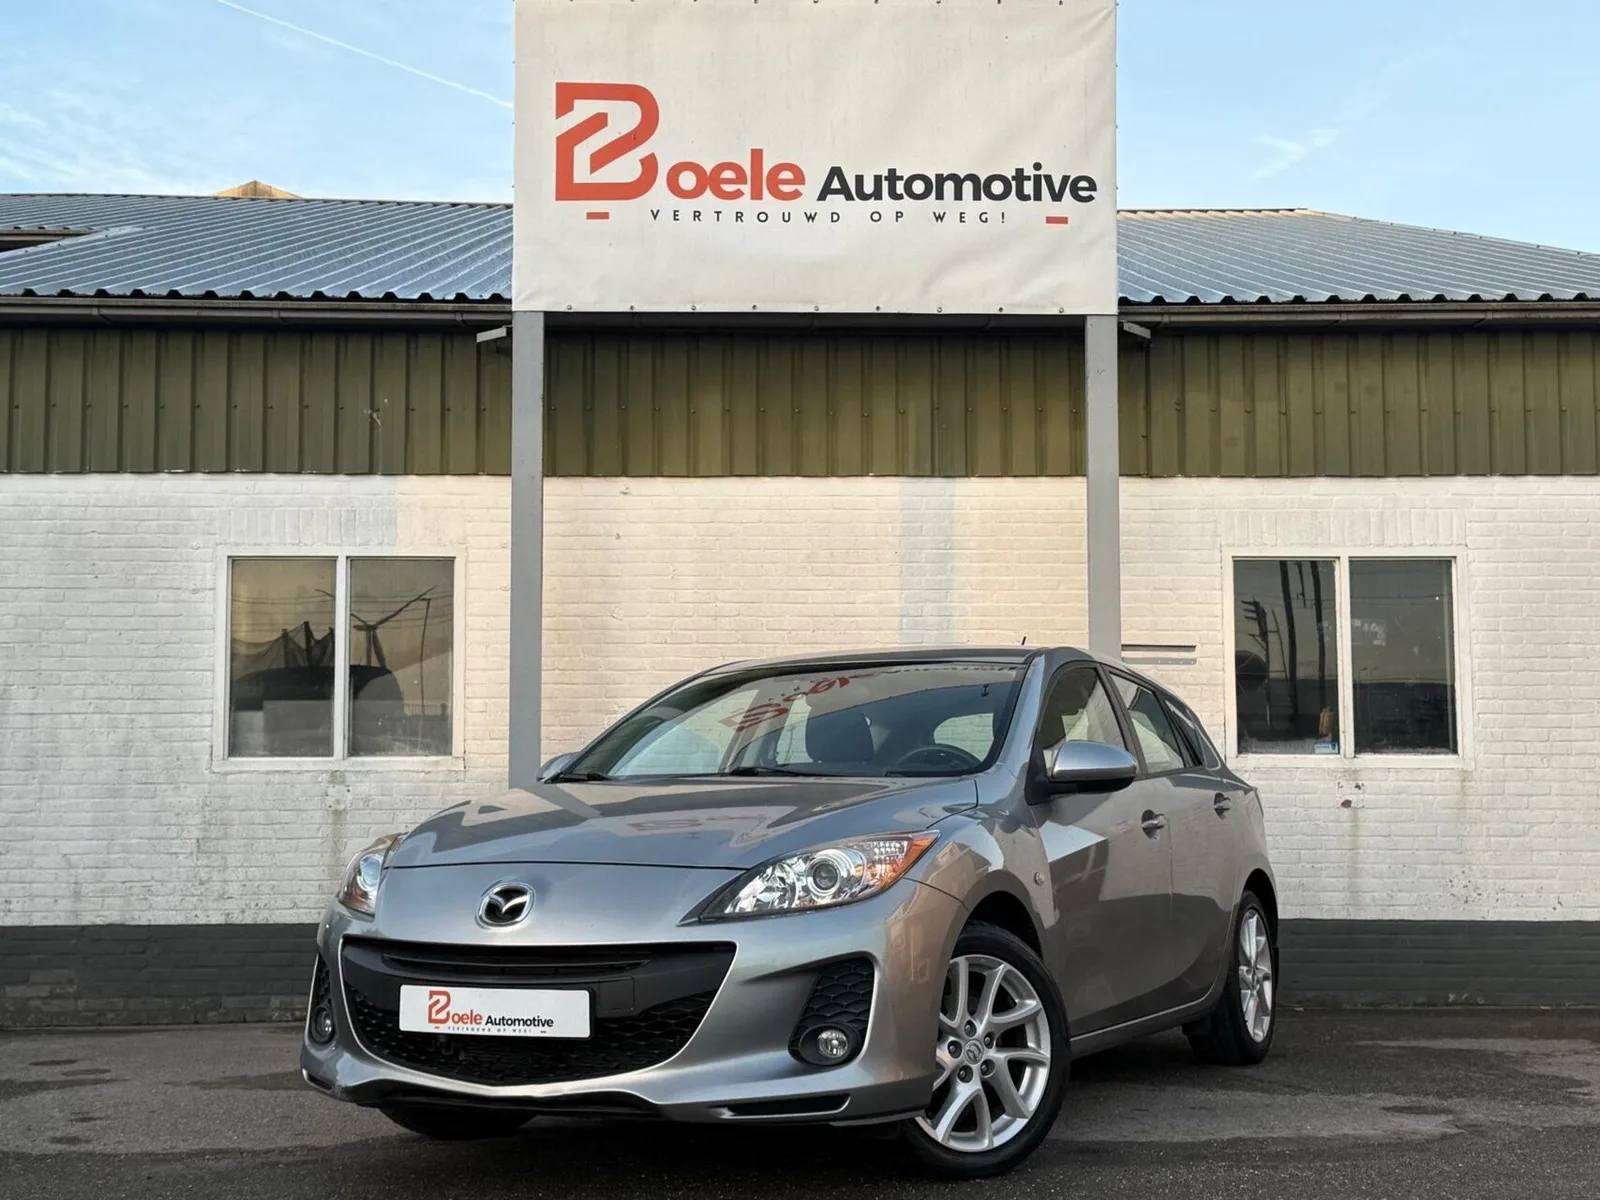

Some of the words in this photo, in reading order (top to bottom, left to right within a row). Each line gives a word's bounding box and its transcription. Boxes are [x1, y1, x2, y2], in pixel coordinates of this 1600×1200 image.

[556, 82, 806, 201] Boele
[817, 162, 1097, 203] Automotive
[650, 209, 841, 223] VERTROUWD
[869, 210, 904, 223] OP
[932, 211, 1006, 224] WEG!
[428, 990, 482, 1025] Boele
[485, 1015, 554, 1028] Automotive
